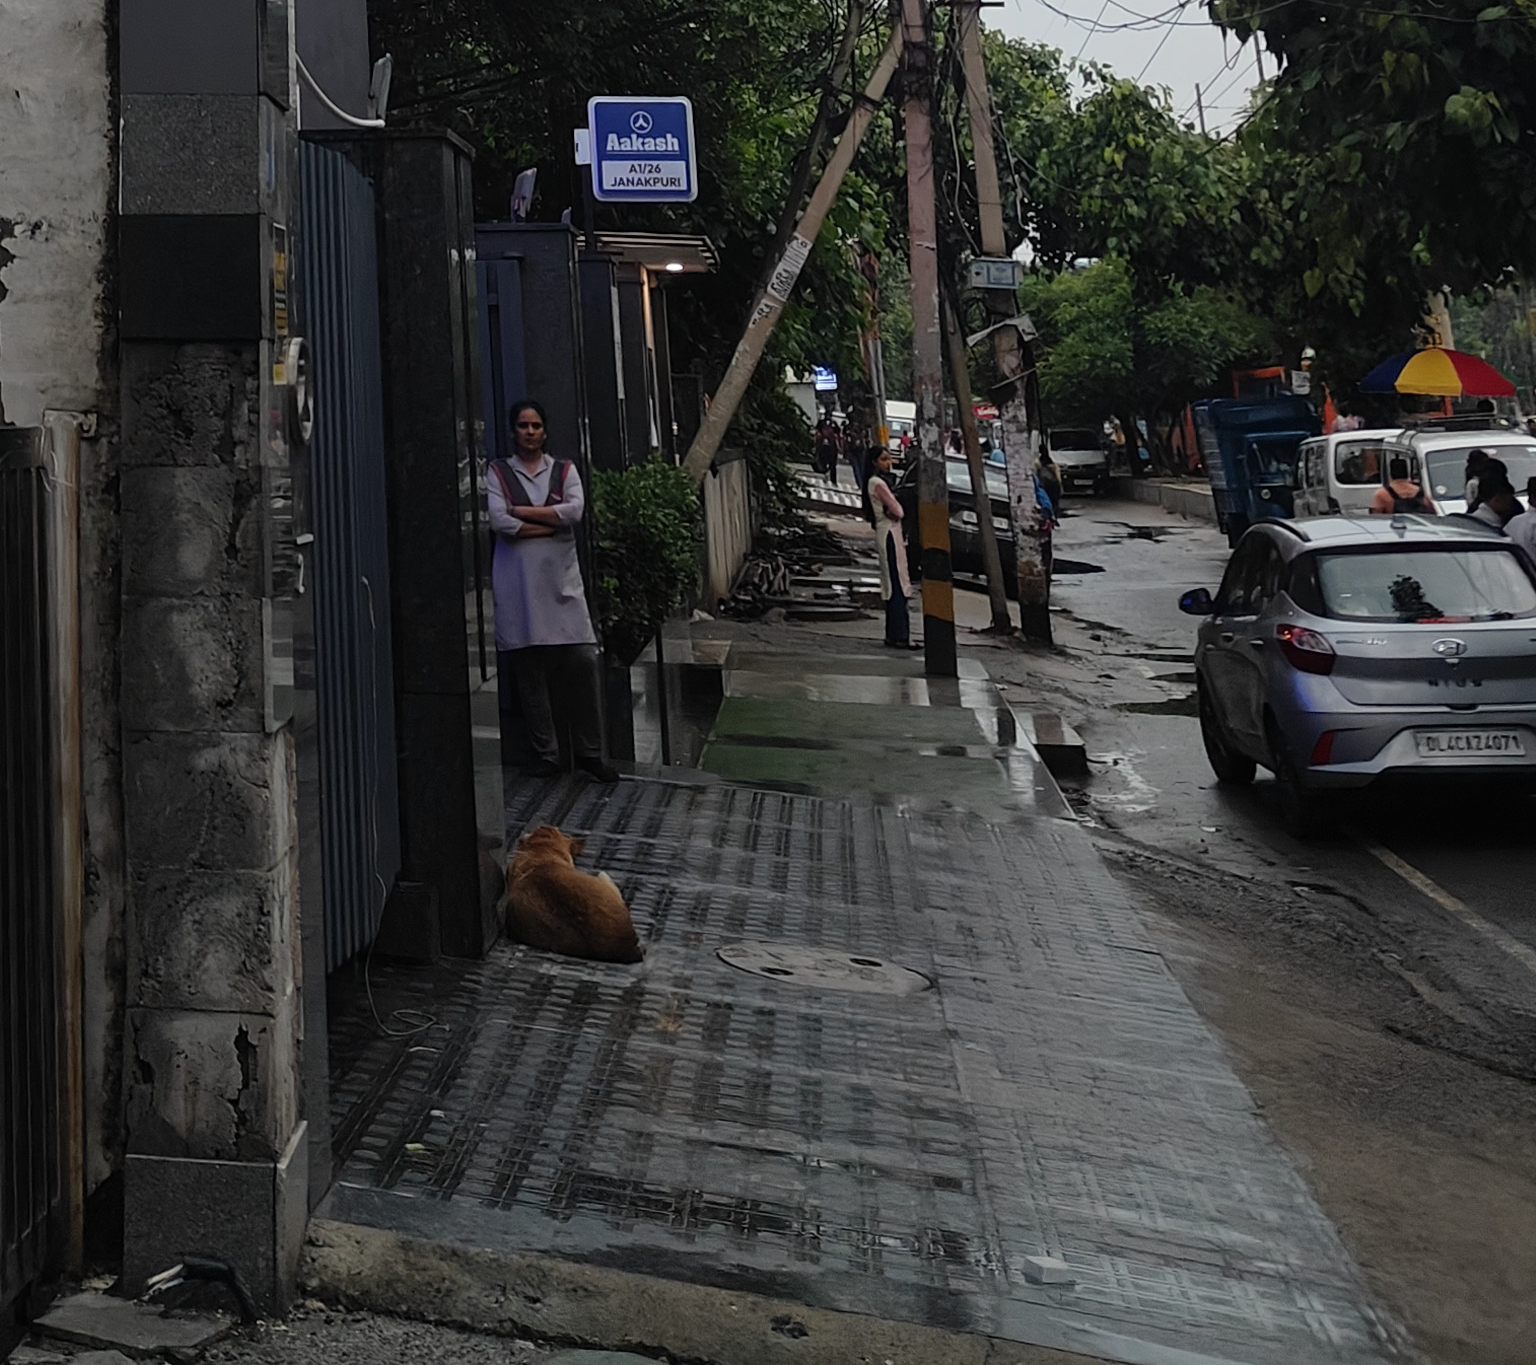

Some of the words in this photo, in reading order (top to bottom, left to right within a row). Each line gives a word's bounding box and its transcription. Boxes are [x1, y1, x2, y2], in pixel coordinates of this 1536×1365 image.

[606, 133, 680, 152] Aakash
[628, 163, 662, 175] A1/26
[611, 176, 681, 188] JANAKPURI
